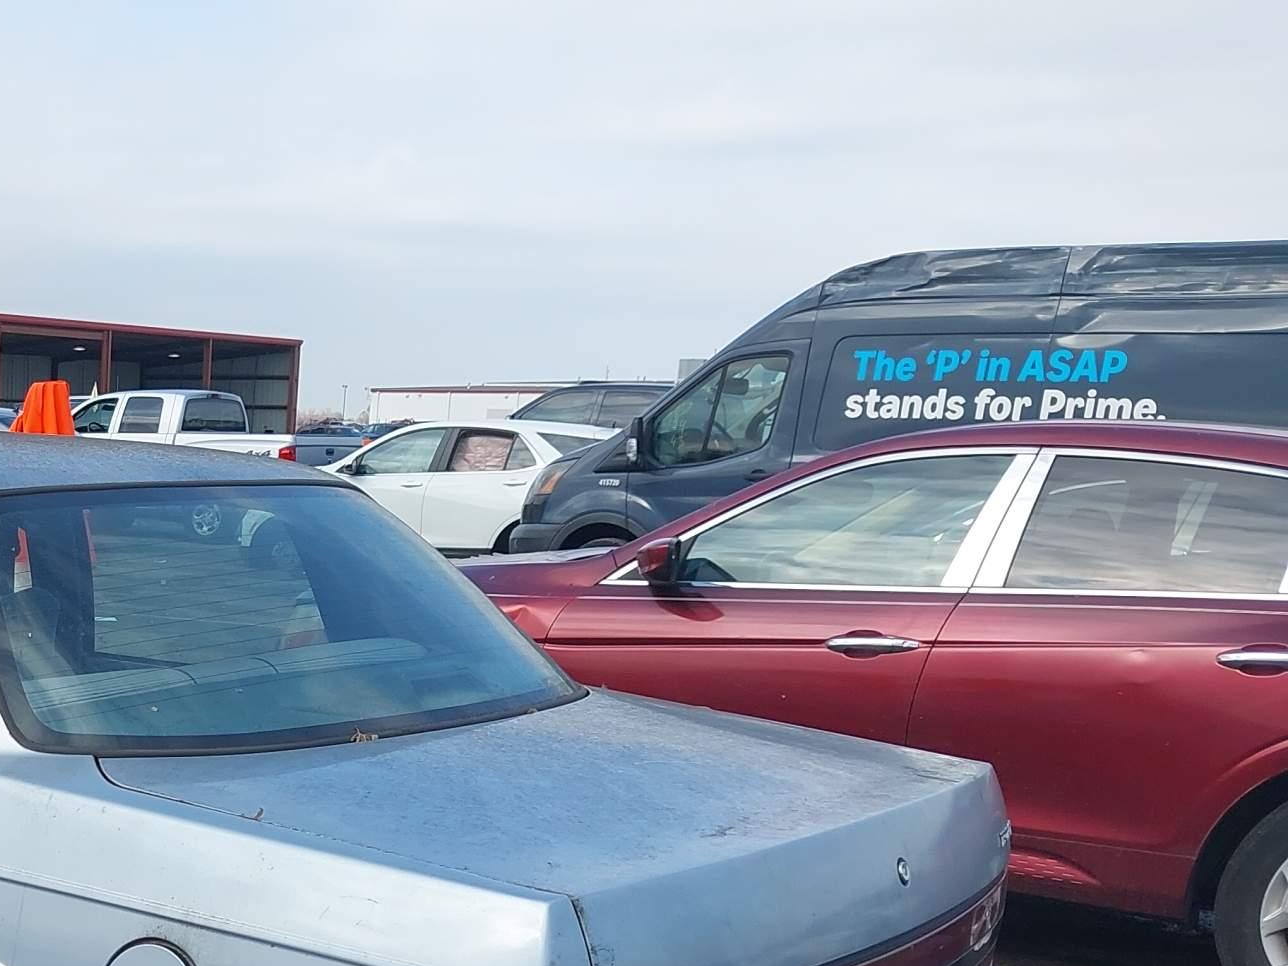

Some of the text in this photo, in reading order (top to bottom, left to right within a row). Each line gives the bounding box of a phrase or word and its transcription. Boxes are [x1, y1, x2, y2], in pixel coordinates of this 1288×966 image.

[854, 350, 917, 381] The
[976, 349, 1010, 382] in
[1017, 349, 1128, 383] ASAP
[844, 388, 1167, 421] stands for Prime.
